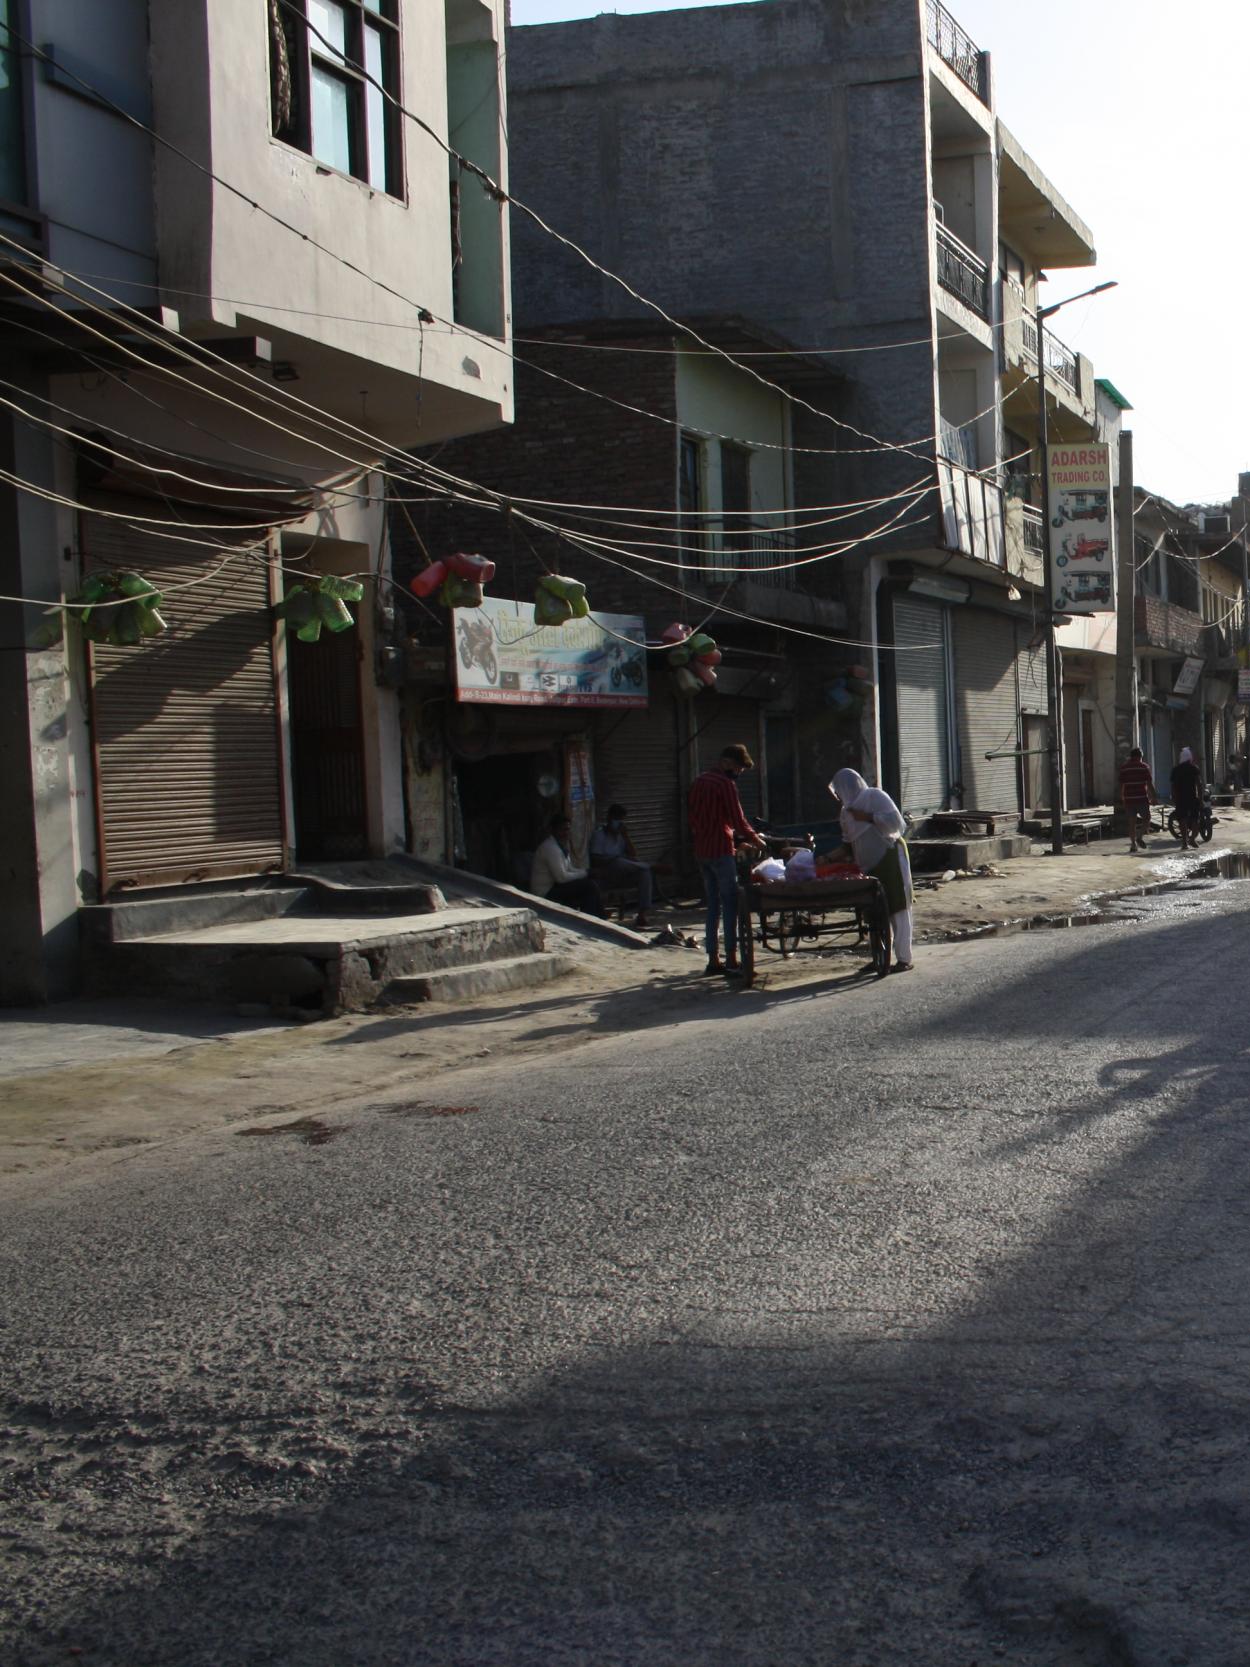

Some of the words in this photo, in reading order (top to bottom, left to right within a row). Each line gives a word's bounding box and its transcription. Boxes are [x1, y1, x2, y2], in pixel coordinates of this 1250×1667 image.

[1051, 449, 1107, 466] ADARSH
[1051, 471, 1089, 484] TRADING
[1092, 471, 1107, 483] CO.
